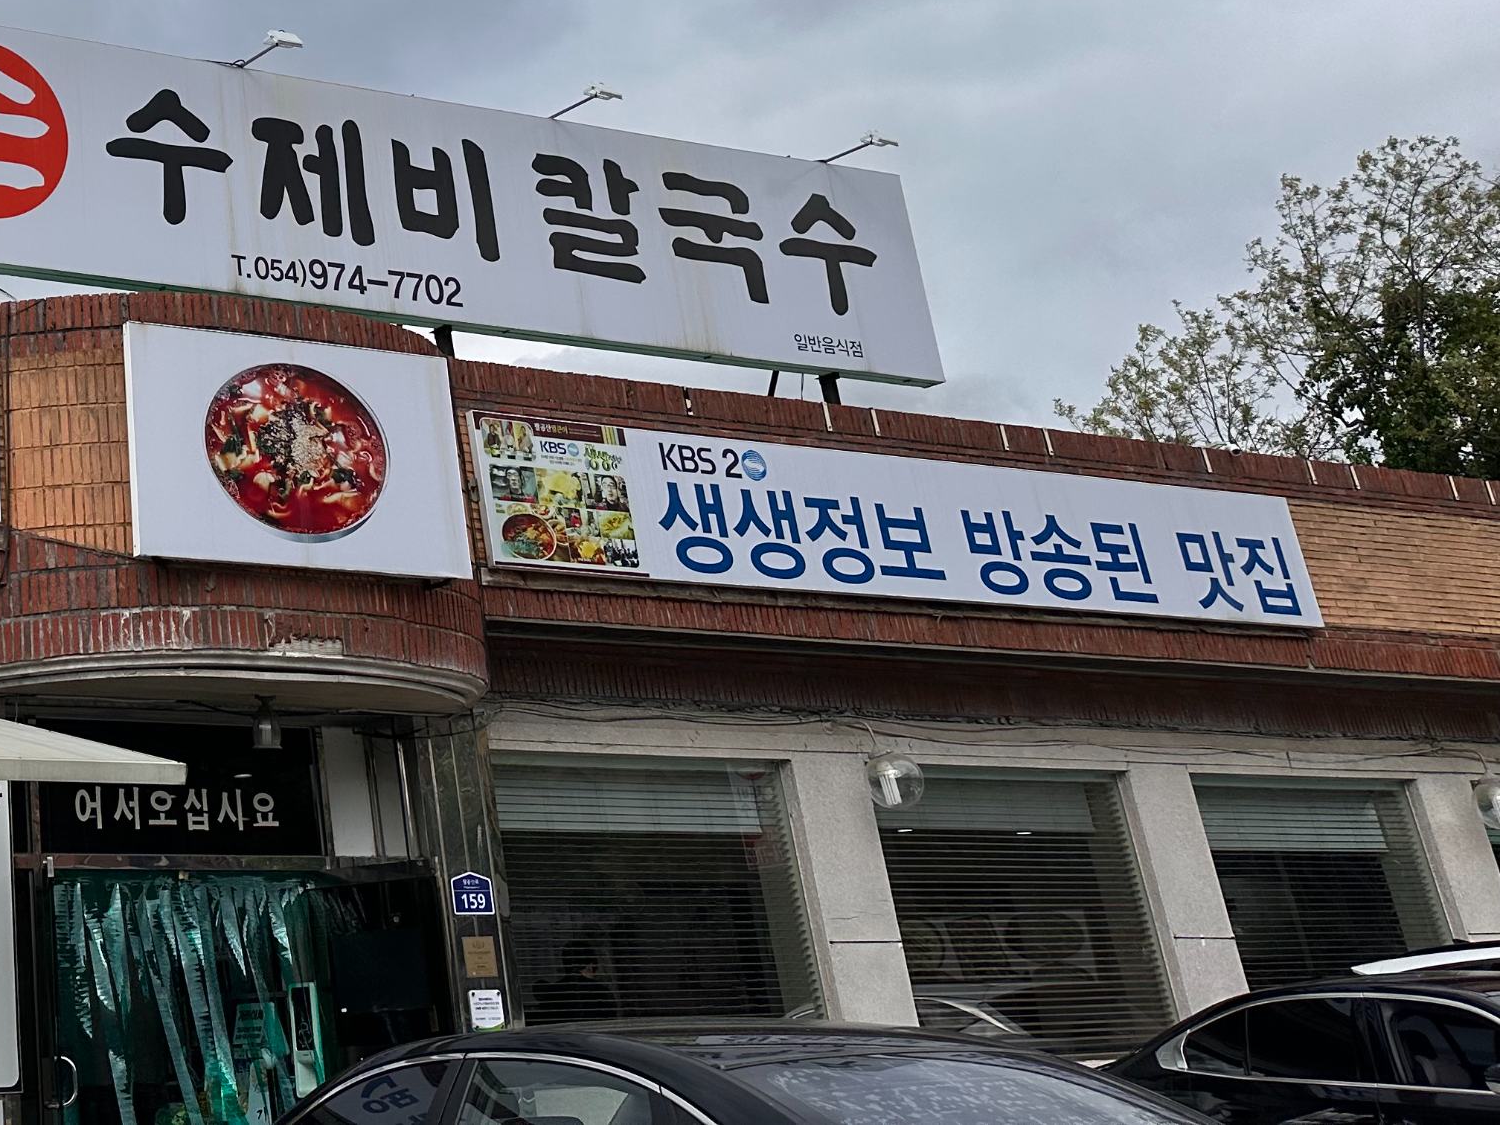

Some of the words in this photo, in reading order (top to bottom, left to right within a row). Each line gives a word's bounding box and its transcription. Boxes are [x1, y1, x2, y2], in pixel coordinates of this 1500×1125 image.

[106, 88, 500, 263] 수제비
[531, 152, 877, 316] 칼국수
[794, 333, 864, 358] 일반음식점
[540, 440, 567, 455] KBS
[658, 442, 716, 475] KBS
[659, 481, 946, 585] 생생정보
[961, 509, 1159, 604] 방송된
[1176, 531, 1303, 617] 맛집
[461, 893, 486, 909] 159
